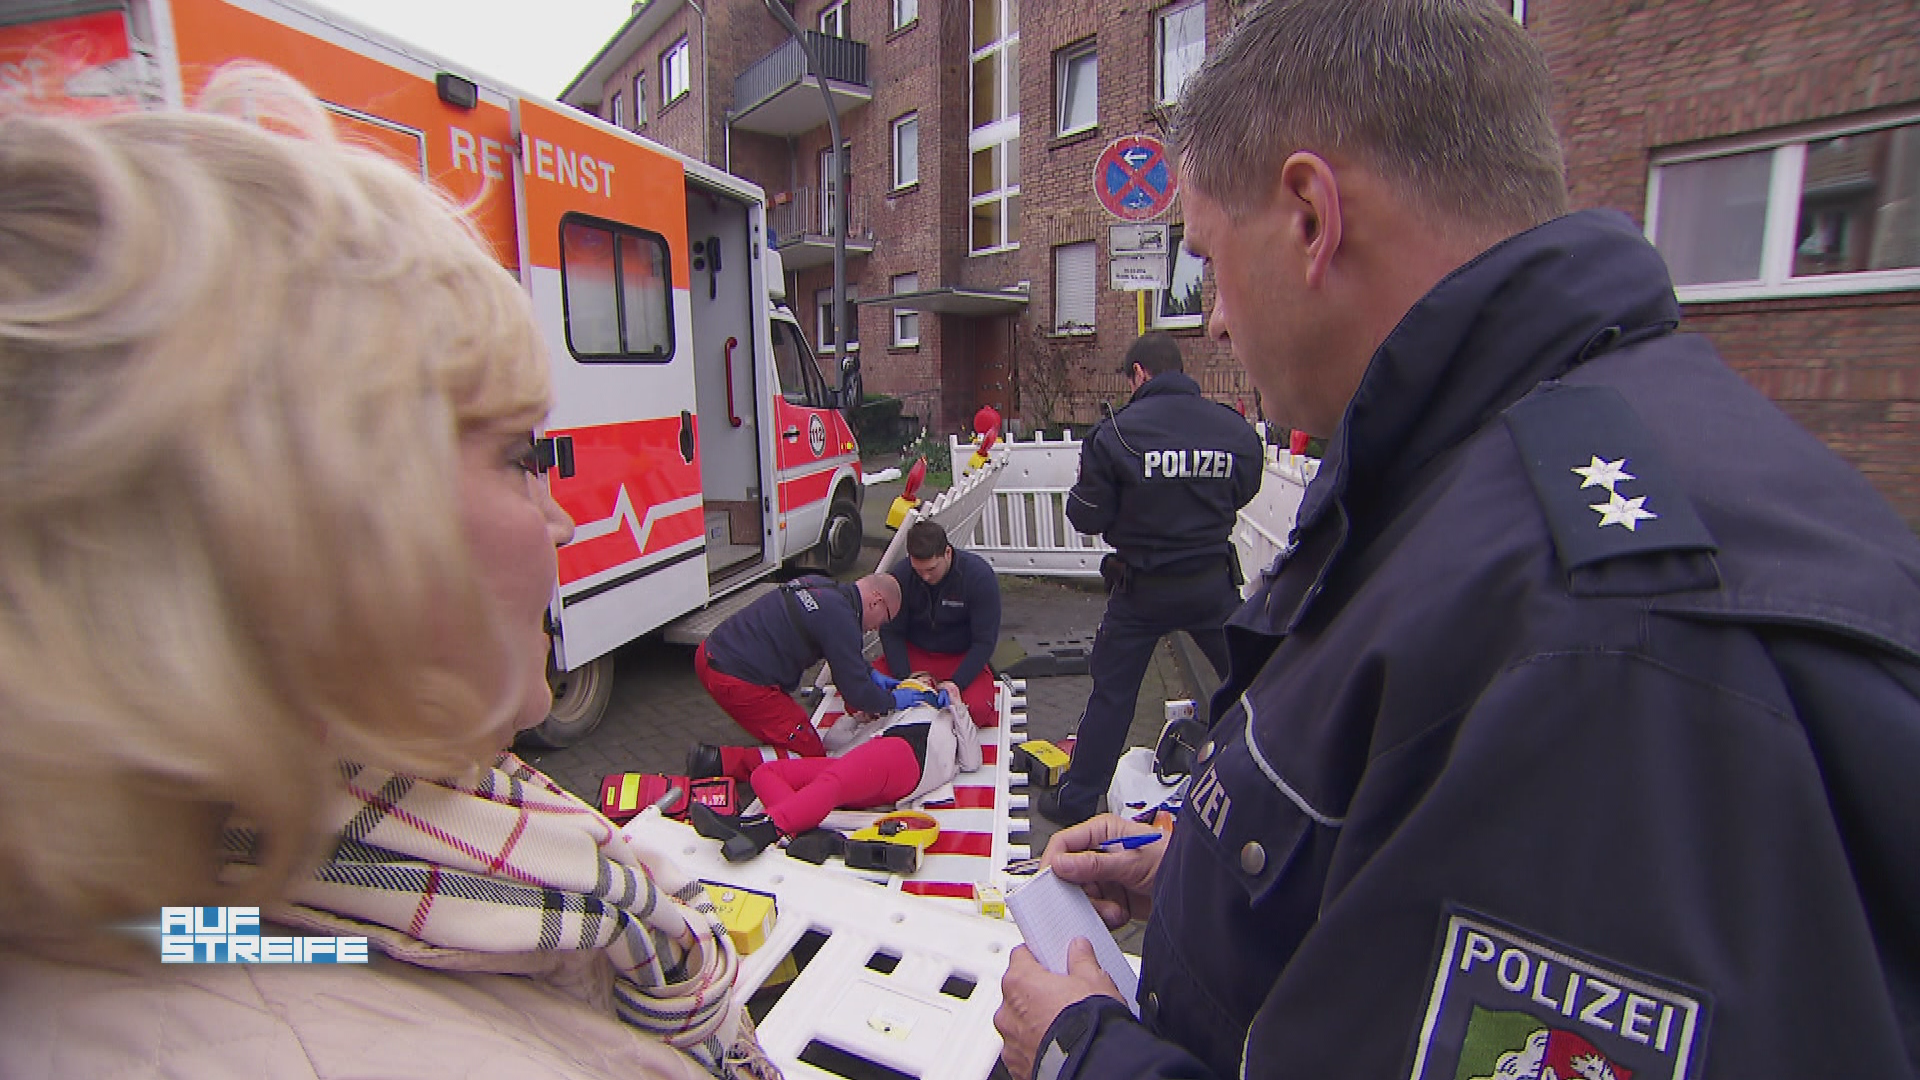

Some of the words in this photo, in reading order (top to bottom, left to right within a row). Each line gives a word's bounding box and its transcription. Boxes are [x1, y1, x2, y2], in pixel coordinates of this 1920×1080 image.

[811, 427, 824, 444] 112
[1144, 449, 1233, 478] POLIZEI
[1460, 931, 1674, 1051] POLIZEI
